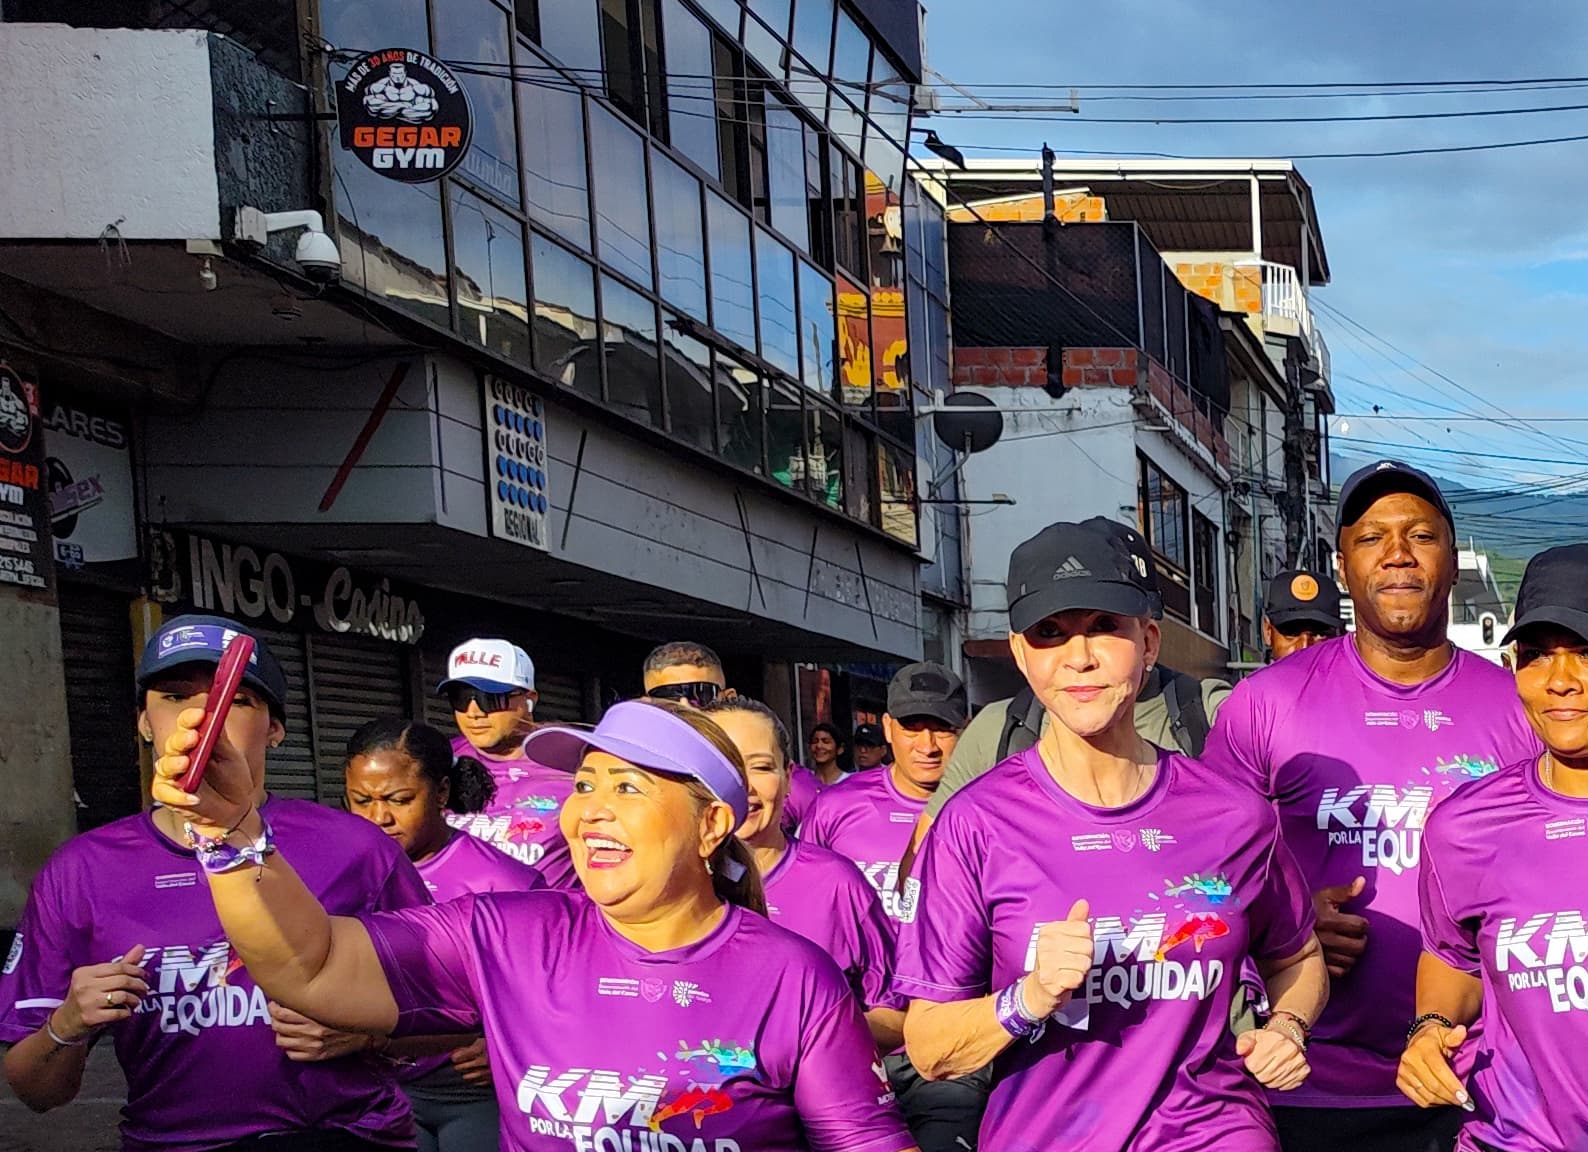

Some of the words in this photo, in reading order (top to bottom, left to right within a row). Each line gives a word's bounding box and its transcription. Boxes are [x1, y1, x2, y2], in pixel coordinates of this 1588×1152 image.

[353, 126, 462, 147] GEGAR
[372, 148, 445, 168] GYM
[43, 405, 123, 445] ARES
[1317, 784, 1434, 830] KM
[1328, 830, 1348, 846] POR
[1348, 830, 1362, 844] LA
[1508, 972, 1531, 993] POR
[1531, 968, 1548, 988] LA
[160, 985, 271, 1036] EQUIDA
[516, 1064, 668, 1127] KM
[530, 1115, 556, 1138] POR
[556, 1120, 574, 1141] LA
